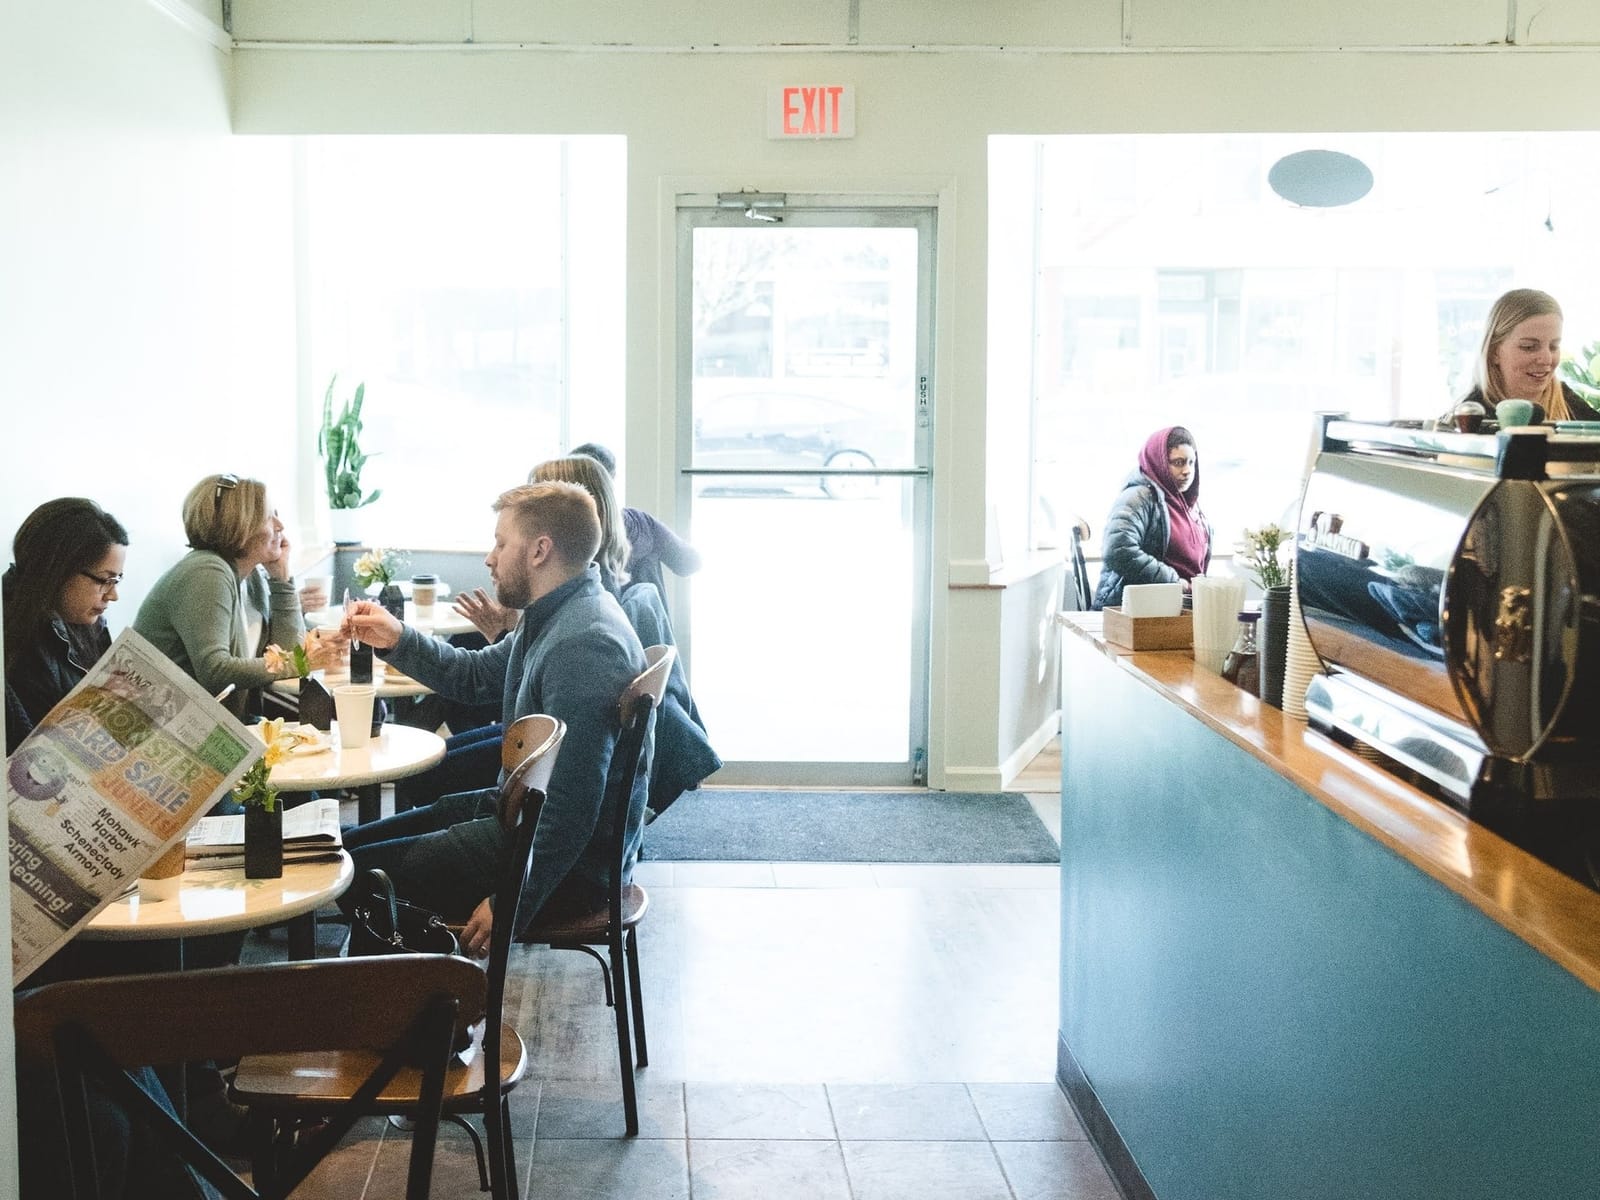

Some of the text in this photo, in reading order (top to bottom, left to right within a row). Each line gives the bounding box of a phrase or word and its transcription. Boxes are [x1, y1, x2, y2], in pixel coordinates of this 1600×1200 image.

[783, 86, 844, 134] EXIT
[59, 704, 127, 766] YARD
[123, 756, 190, 814] SALE
[83, 691, 203, 788] MONSTER
[61, 819, 125, 880] Schenectady
[91, 819, 127, 853] Harbor
[98, 807, 140, 848] Mohawk
[64, 842, 102, 878] Armory
